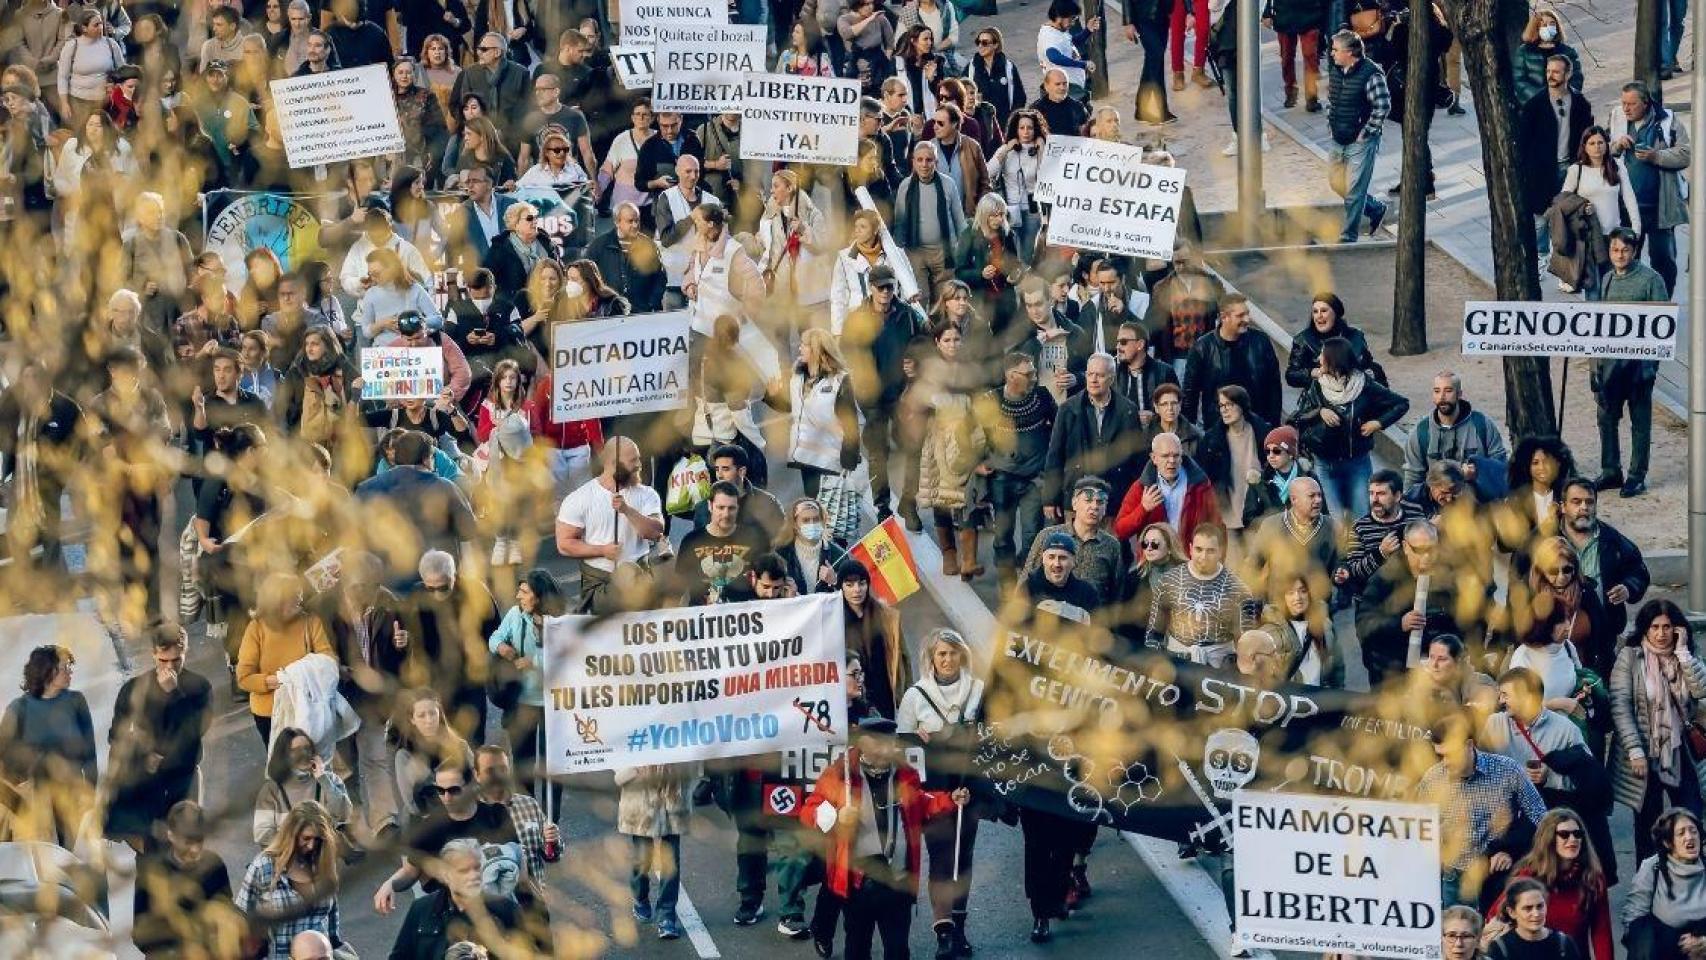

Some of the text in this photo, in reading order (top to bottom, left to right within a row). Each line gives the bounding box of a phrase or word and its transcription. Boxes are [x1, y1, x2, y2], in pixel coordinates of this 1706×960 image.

[636, 7, 712, 19] QUE NUNCA
[624, 25, 650, 37] NOS
[668, 52, 753, 72] RESPIRA
[656, 83, 743, 101] LIBERTA
[746, 81, 858, 104] LIBERTAD
[744, 108, 858, 126] CONSTITUYENTE
[779, 133, 820, 150] ¡YA!
[1063, 162, 1179, 193] El COVID es
[1056, 195, 1175, 223] una ESTAFA
[1071, 223, 1152, 244] Covid is a scam
[1464, 310, 1677, 340] GENOCIDIO
[555, 335, 688, 369] DICTADURA
[1479, 341, 1657, 356] CanariasSeLevanta_voluntarios
[561, 370, 679, 402] SANITARIA
[623, 611, 764, 646] LOS POLÍTICOS
[585, 635, 803, 678] SOLO QUIEREN TU VOTO
[551, 661, 839, 711] TU LES IMPORTAS UNA MIERDA
[799, 699, 832, 734] 78
[1195, 677, 1319, 727] STOP
[627, 712, 779, 752] #YoNoVoto
[1238, 805, 1433, 841] ENAMÓRATE
[1295, 851, 1379, 879] DE LA
[1240, 889, 1436, 929] LIBERTAD
[1253, 933, 1424, 956] CanariasSeLevanta_voluntarios
